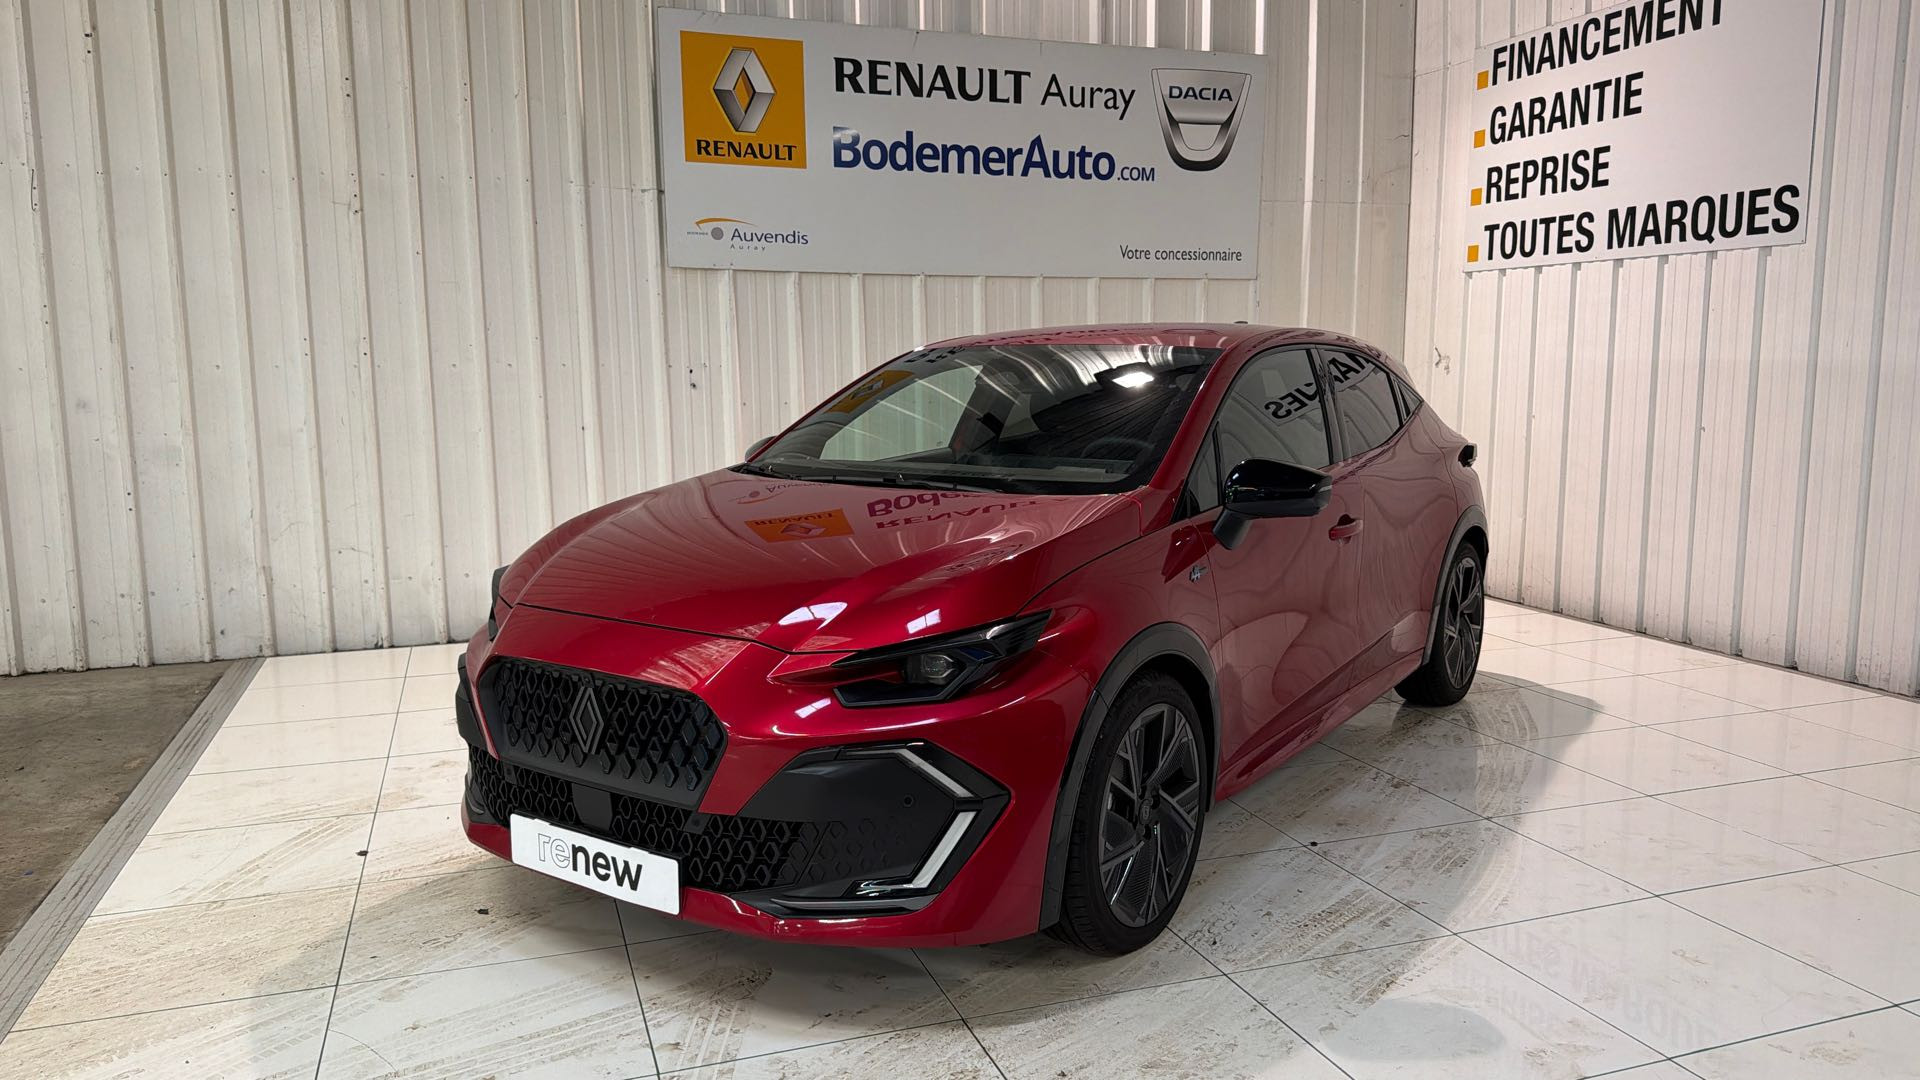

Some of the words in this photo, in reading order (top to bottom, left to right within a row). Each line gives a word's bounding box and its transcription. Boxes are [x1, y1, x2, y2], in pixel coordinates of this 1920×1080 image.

[833, 57, 1031, 104] RENAULT
[1040, 73, 1136, 121] Auray
[1168, 85, 1233, 102] DACIA
[1489, 71, 1644, 145] GARANTIE
[696, 139, 797, 161] RENAULT
[1485, 145, 1611, 204] REPRISE
[731, 228, 809, 245] Auvendis
[1484, 211, 1595, 260] TOUTES
[1606, 184, 1800, 249] MARQUES
[1119, 244, 1150, 260] Votre
[1155, 247, 1242, 262] concessionnaire
[537, 833, 643, 891] renew
